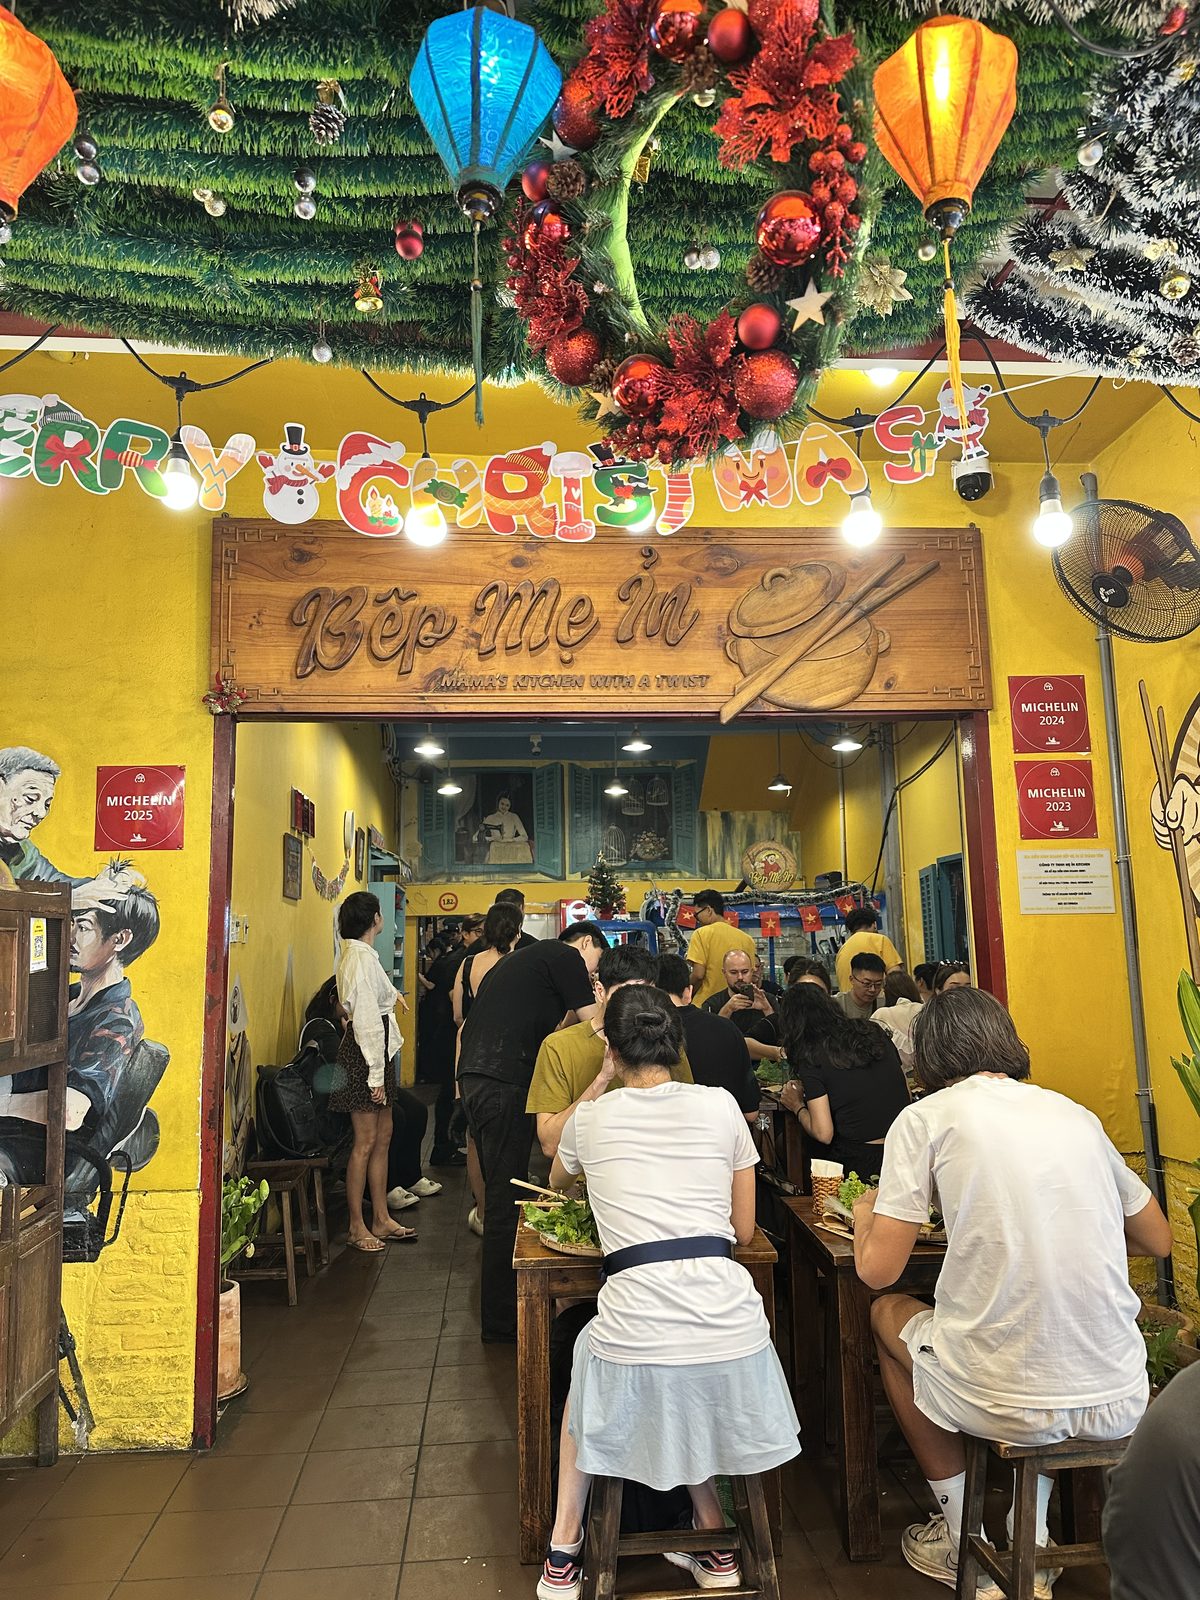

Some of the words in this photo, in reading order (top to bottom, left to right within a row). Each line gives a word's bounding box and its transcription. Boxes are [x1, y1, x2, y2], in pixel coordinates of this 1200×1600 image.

[291, 585, 458, 679] Bếp
[475, 577, 600, 665] Mẹ
[440, 673, 508, 690] MAMA'S
[512, 673, 585, 690] KITCHEN
[589, 673, 636, 689] WITH
[637, 674, 650, 688] A
[655, 673, 711, 689] TWIST
[1021, 702, 1079, 713] MICHELIN
[1039, 715, 1065, 726] 2024
[1027, 788, 1086, 799] MICHELIN
[106, 795, 172, 807] MICHELIN
[1045, 801, 1072, 812] 2023
[124, 810, 153, 821] 2025
